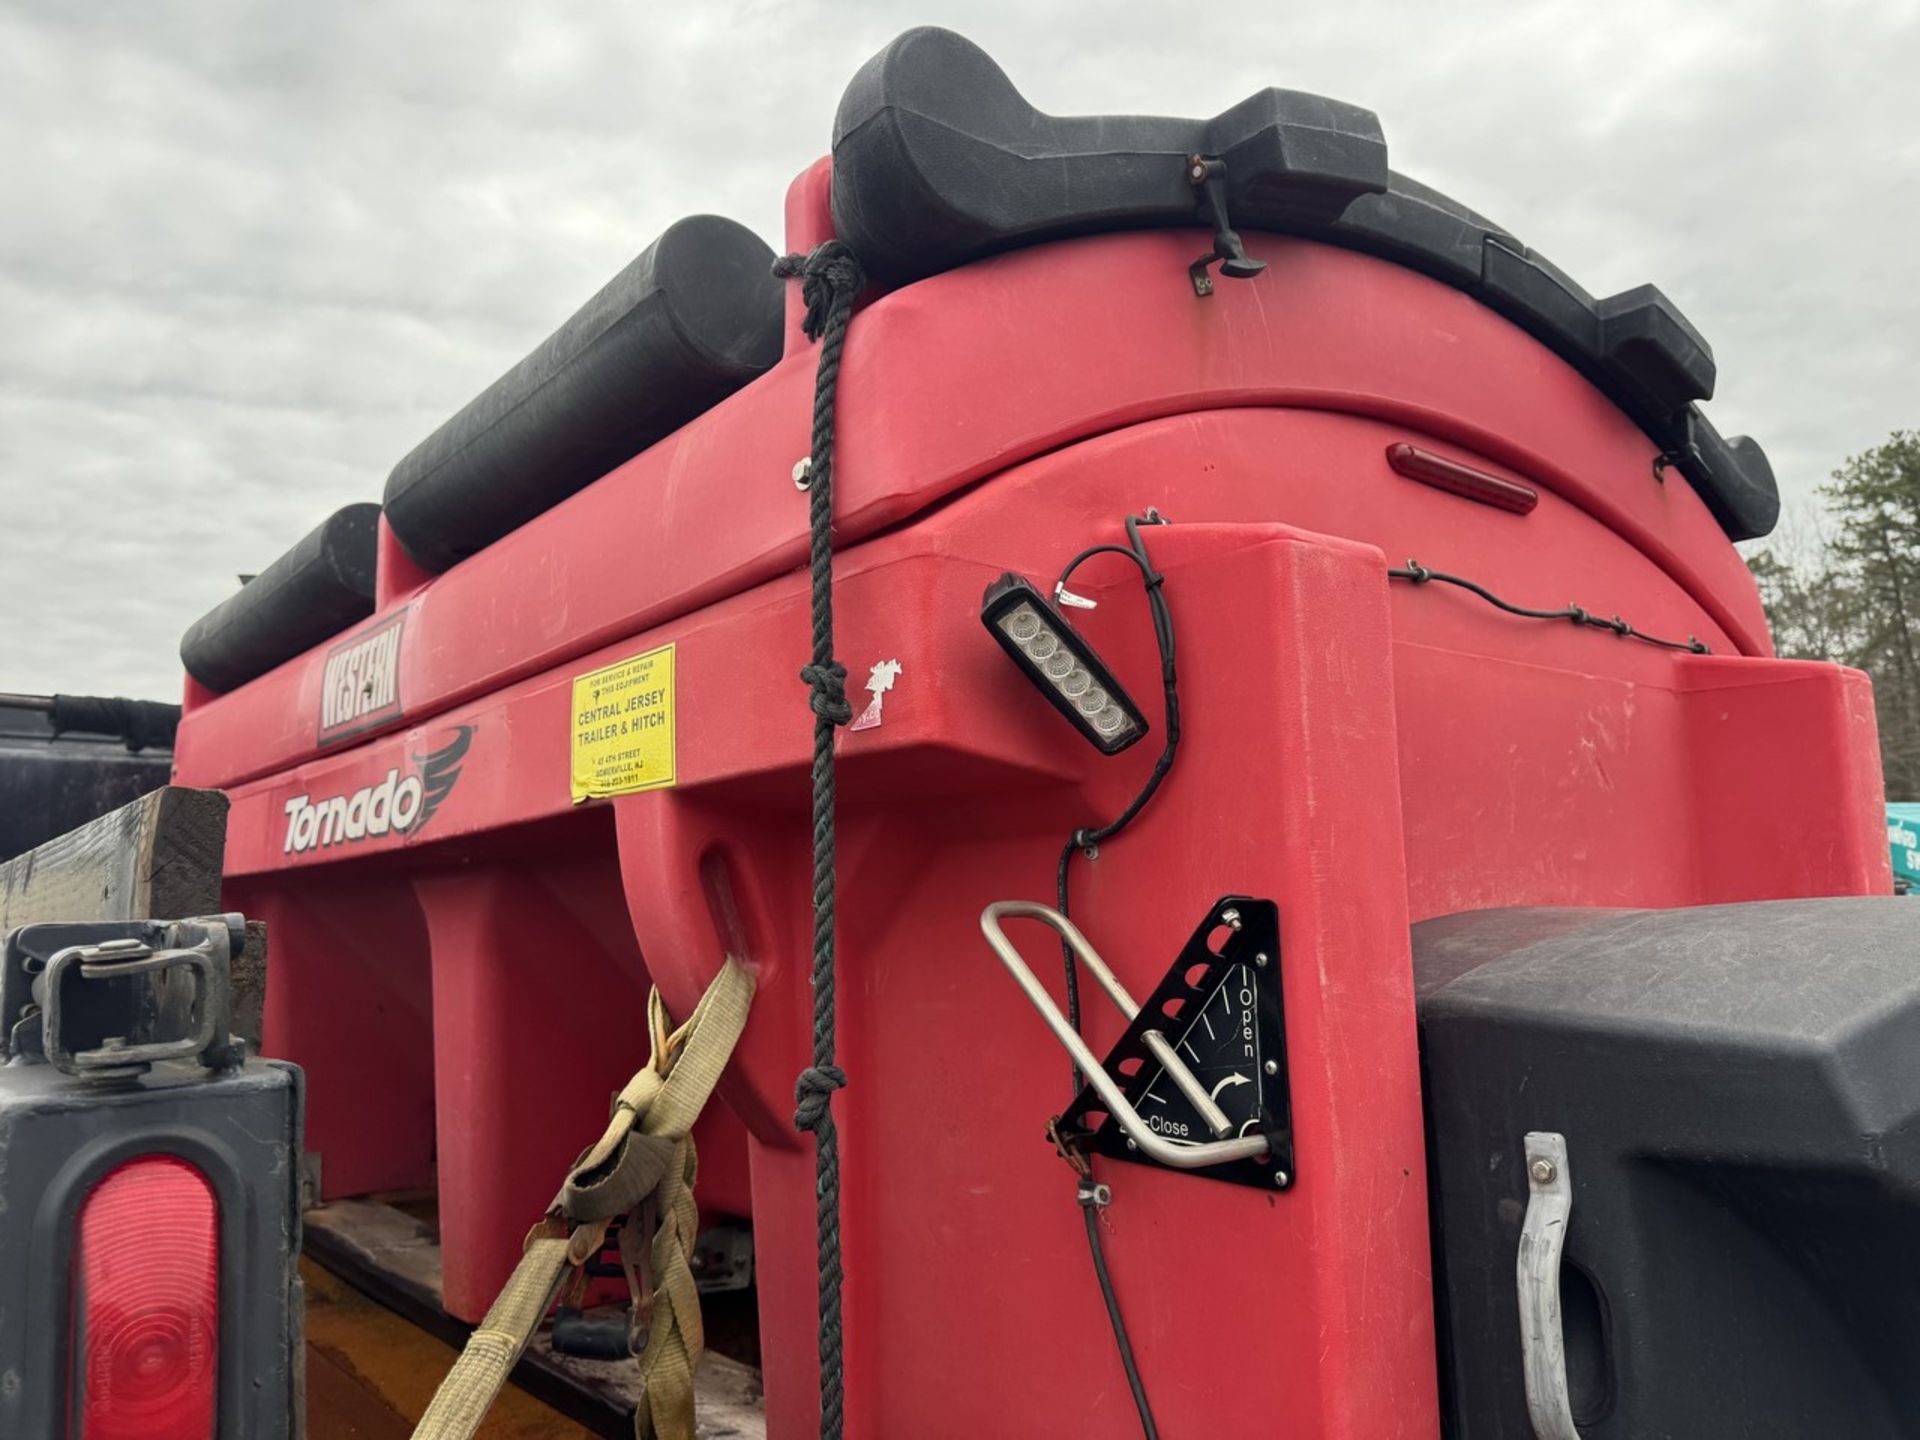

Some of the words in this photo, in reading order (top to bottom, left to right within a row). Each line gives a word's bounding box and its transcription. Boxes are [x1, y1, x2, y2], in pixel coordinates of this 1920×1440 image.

[322, 622, 402, 729] WESTERN
[589, 678, 601, 689] FOR
[602, 669, 625, 684] SERVICE
[632, 660, 654, 674] REPAIR
[615, 673, 650, 690] EQUIPMENT
[578, 703, 621, 726] CENTRAL
[625, 688, 666, 712] JERSEY
[578, 723, 621, 746] TRAILER
[621, 720, 628, 735] &
[631, 711, 665, 732] HITCH
[617, 748, 641, 761] STREET
[283, 768, 423, 854] Tornado
[1239, 988, 1254, 1057] Open
[1149, 1115, 1189, 1137] Close
